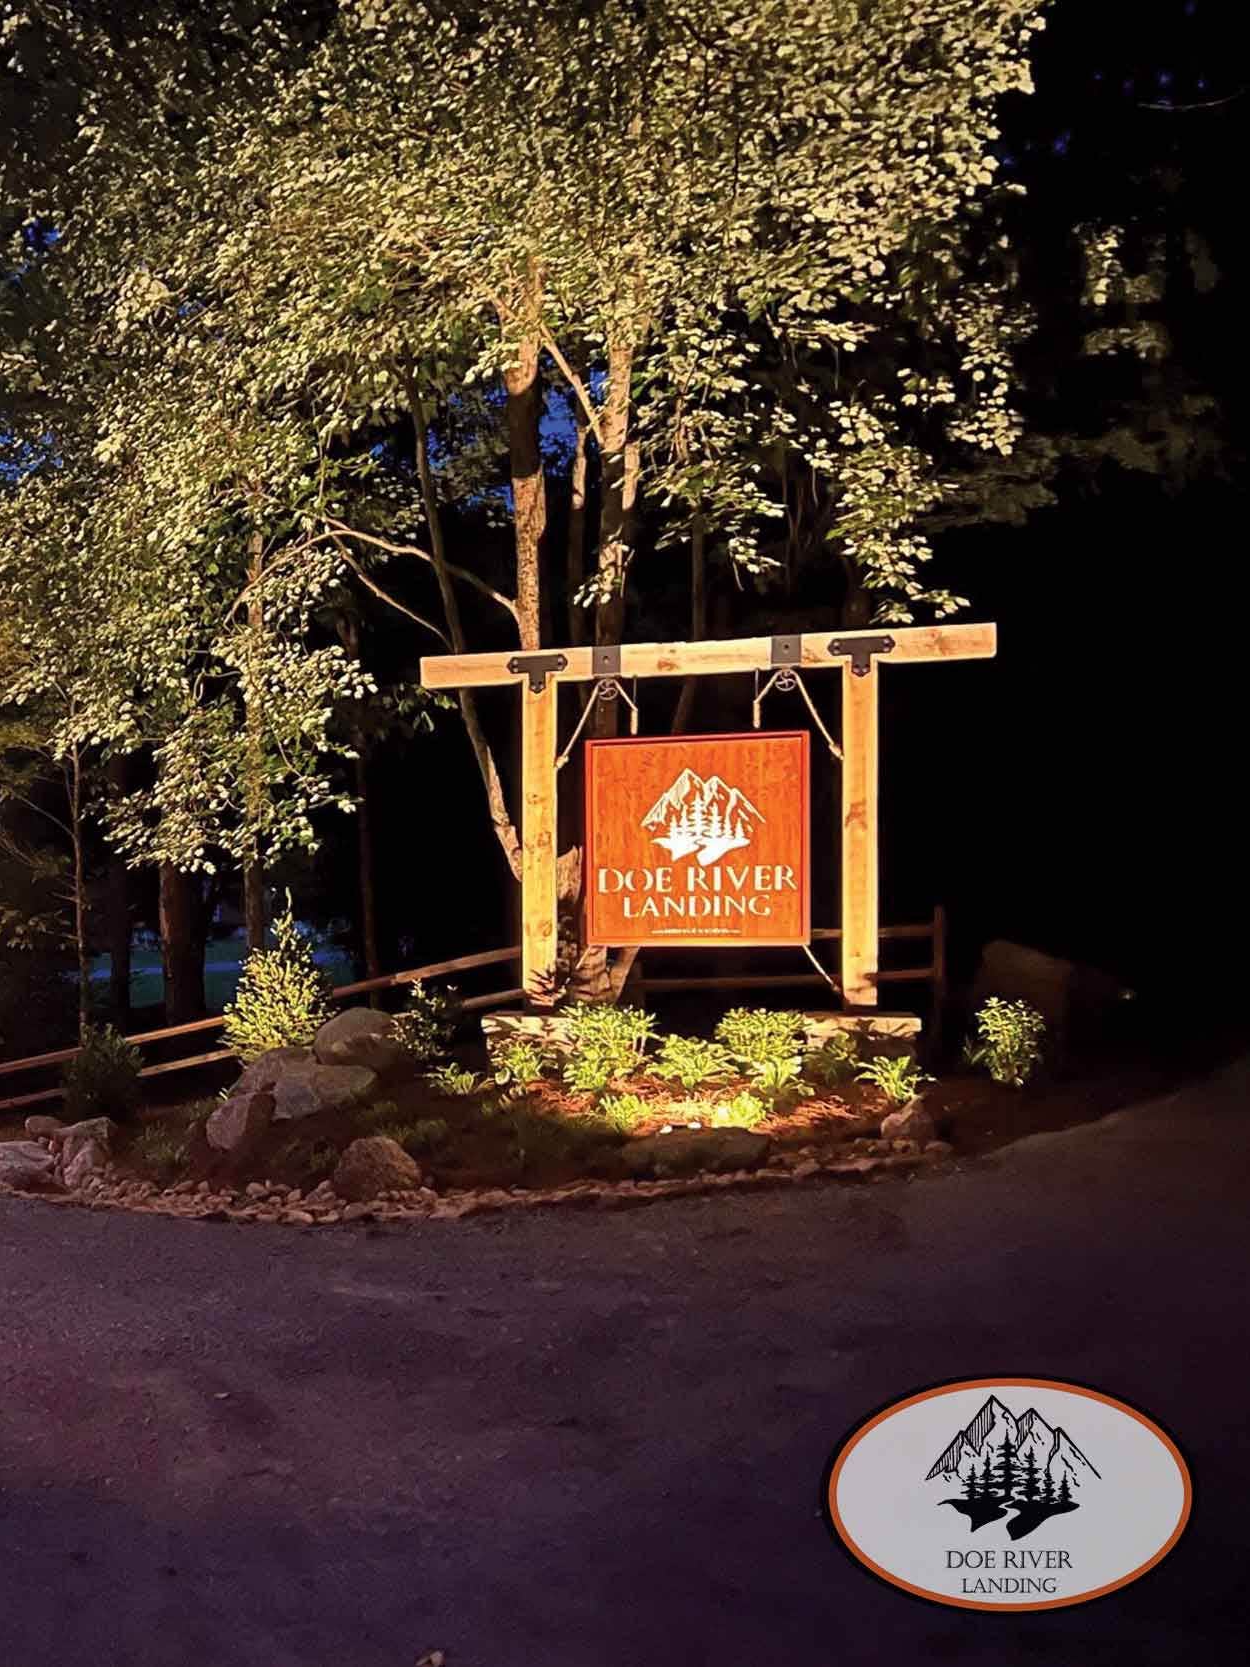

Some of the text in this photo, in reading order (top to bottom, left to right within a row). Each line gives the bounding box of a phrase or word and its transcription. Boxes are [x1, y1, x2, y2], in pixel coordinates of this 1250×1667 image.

[598, 864, 797, 893] DOE RIVER
[623, 894, 772, 918] LANDING
